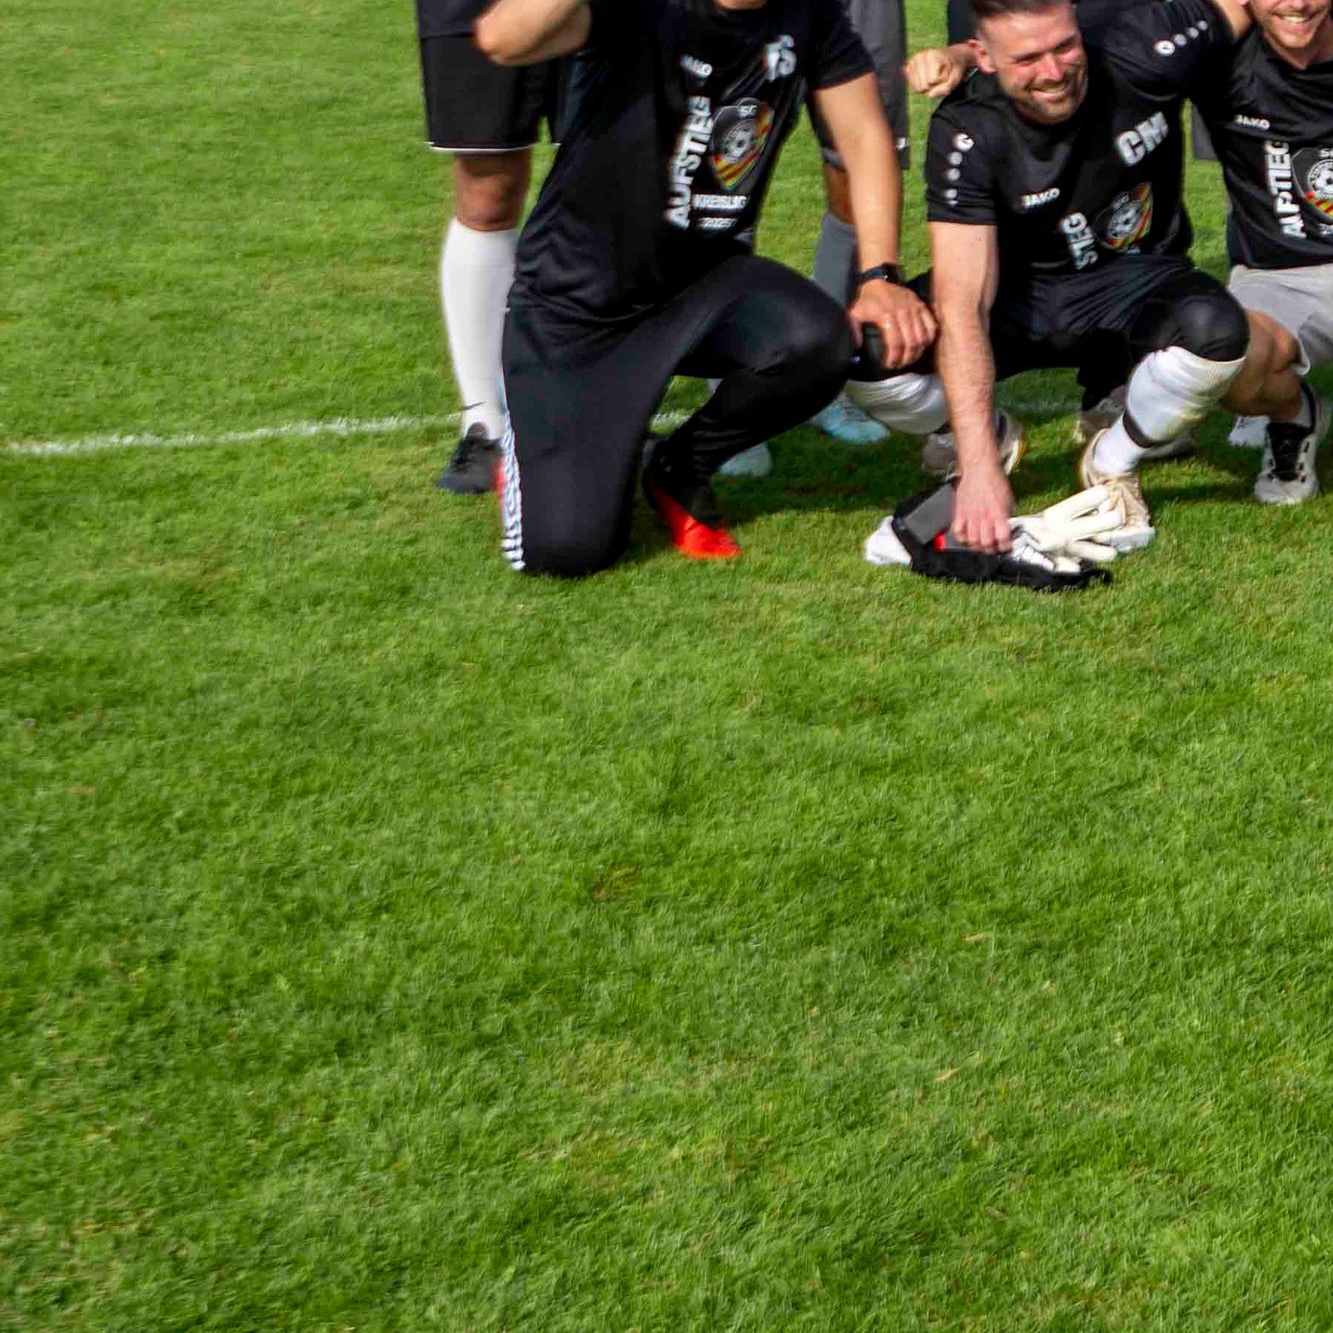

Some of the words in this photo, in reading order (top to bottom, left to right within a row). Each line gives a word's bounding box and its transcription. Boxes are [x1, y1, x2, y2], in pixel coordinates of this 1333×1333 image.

[665, 96, 713, 230] AUFSTIEG
[1022, 188, 1060, 209] JAKO
[1060, 212, 1098, 270] STIEG
